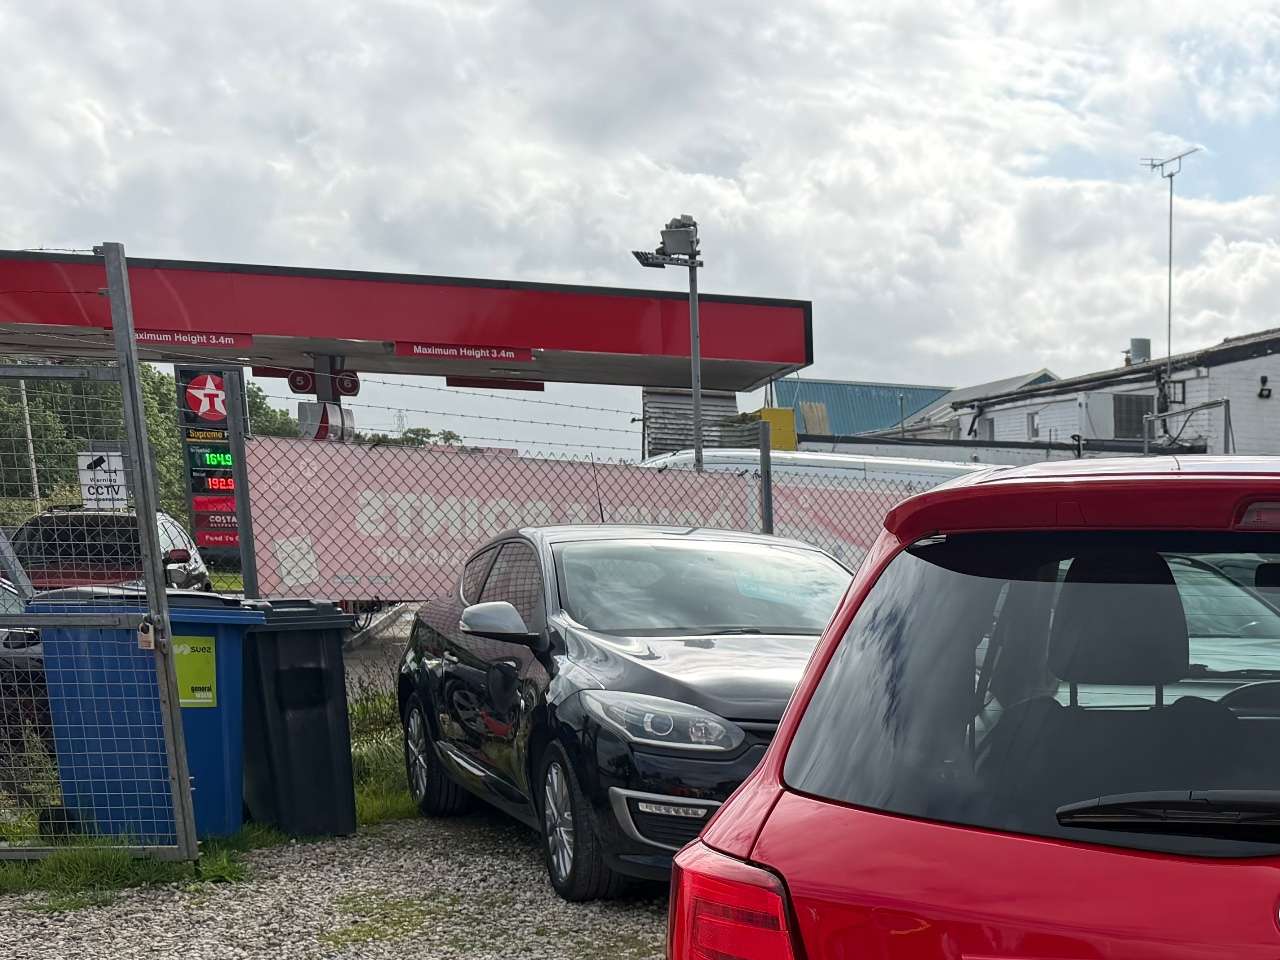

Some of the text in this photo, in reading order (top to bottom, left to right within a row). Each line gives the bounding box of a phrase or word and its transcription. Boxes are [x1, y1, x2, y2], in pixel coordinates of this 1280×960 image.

[135, 331, 234, 345] aximum Height 3.4m
[413, 345, 515, 359] Maximum Height 3.4m
[189, 430, 223, 439] Supreme
[87, 485, 120, 496] CCTV
[209, 515, 238, 523] COSTA
